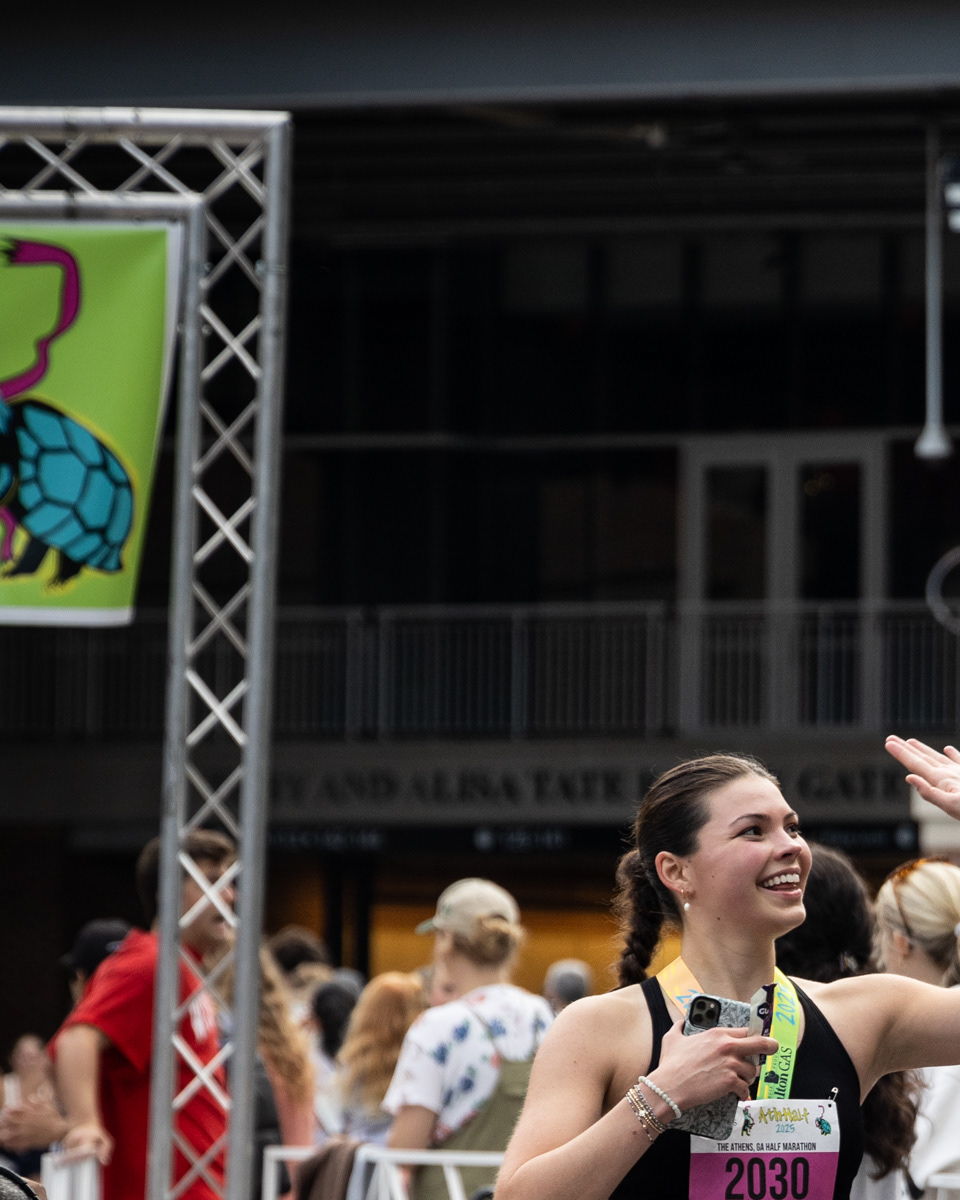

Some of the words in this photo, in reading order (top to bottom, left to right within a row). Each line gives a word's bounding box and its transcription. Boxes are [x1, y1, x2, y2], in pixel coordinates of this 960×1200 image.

[532, 766, 622, 804] TATE
[778, 1046, 793, 1072] GAS
[775, 1123, 796, 1134] 2025
[717, 1142, 730, 1151] THE
[731, 1142, 755, 1152] ATHENS,
[756, 1142, 765, 1151] GA
[766, 1142, 781, 1151] HALF
[782, 1142, 817, 1151] MARATHON
[725, 1156, 810, 1200] 2030
